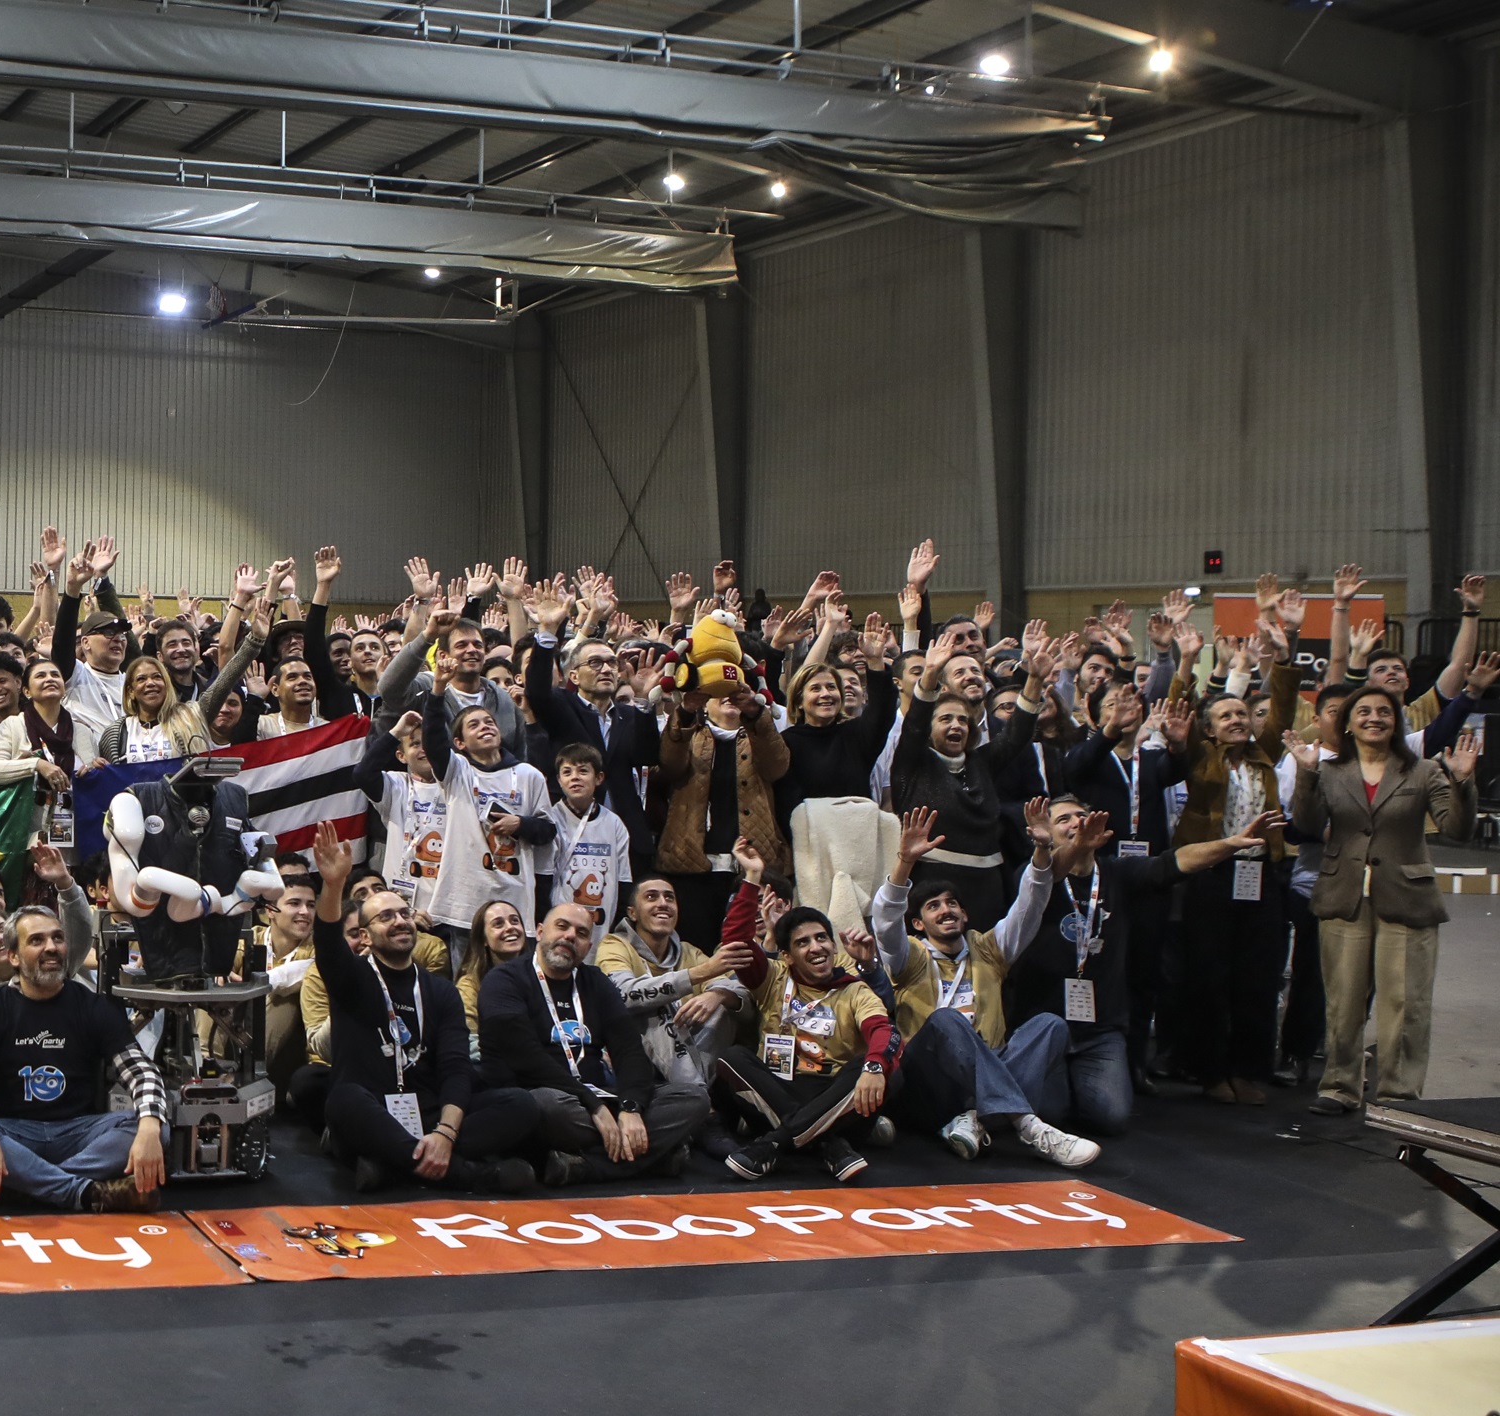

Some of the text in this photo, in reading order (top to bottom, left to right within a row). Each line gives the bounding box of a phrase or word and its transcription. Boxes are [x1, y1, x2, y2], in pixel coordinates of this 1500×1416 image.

[574, 845, 588, 853] obo
[572, 857, 607, 868] 2025
[798, 1016, 831, 1032] 025
[15, 1037, 34, 1045] Let's
[411, 1212, 756, 1249] Robo
